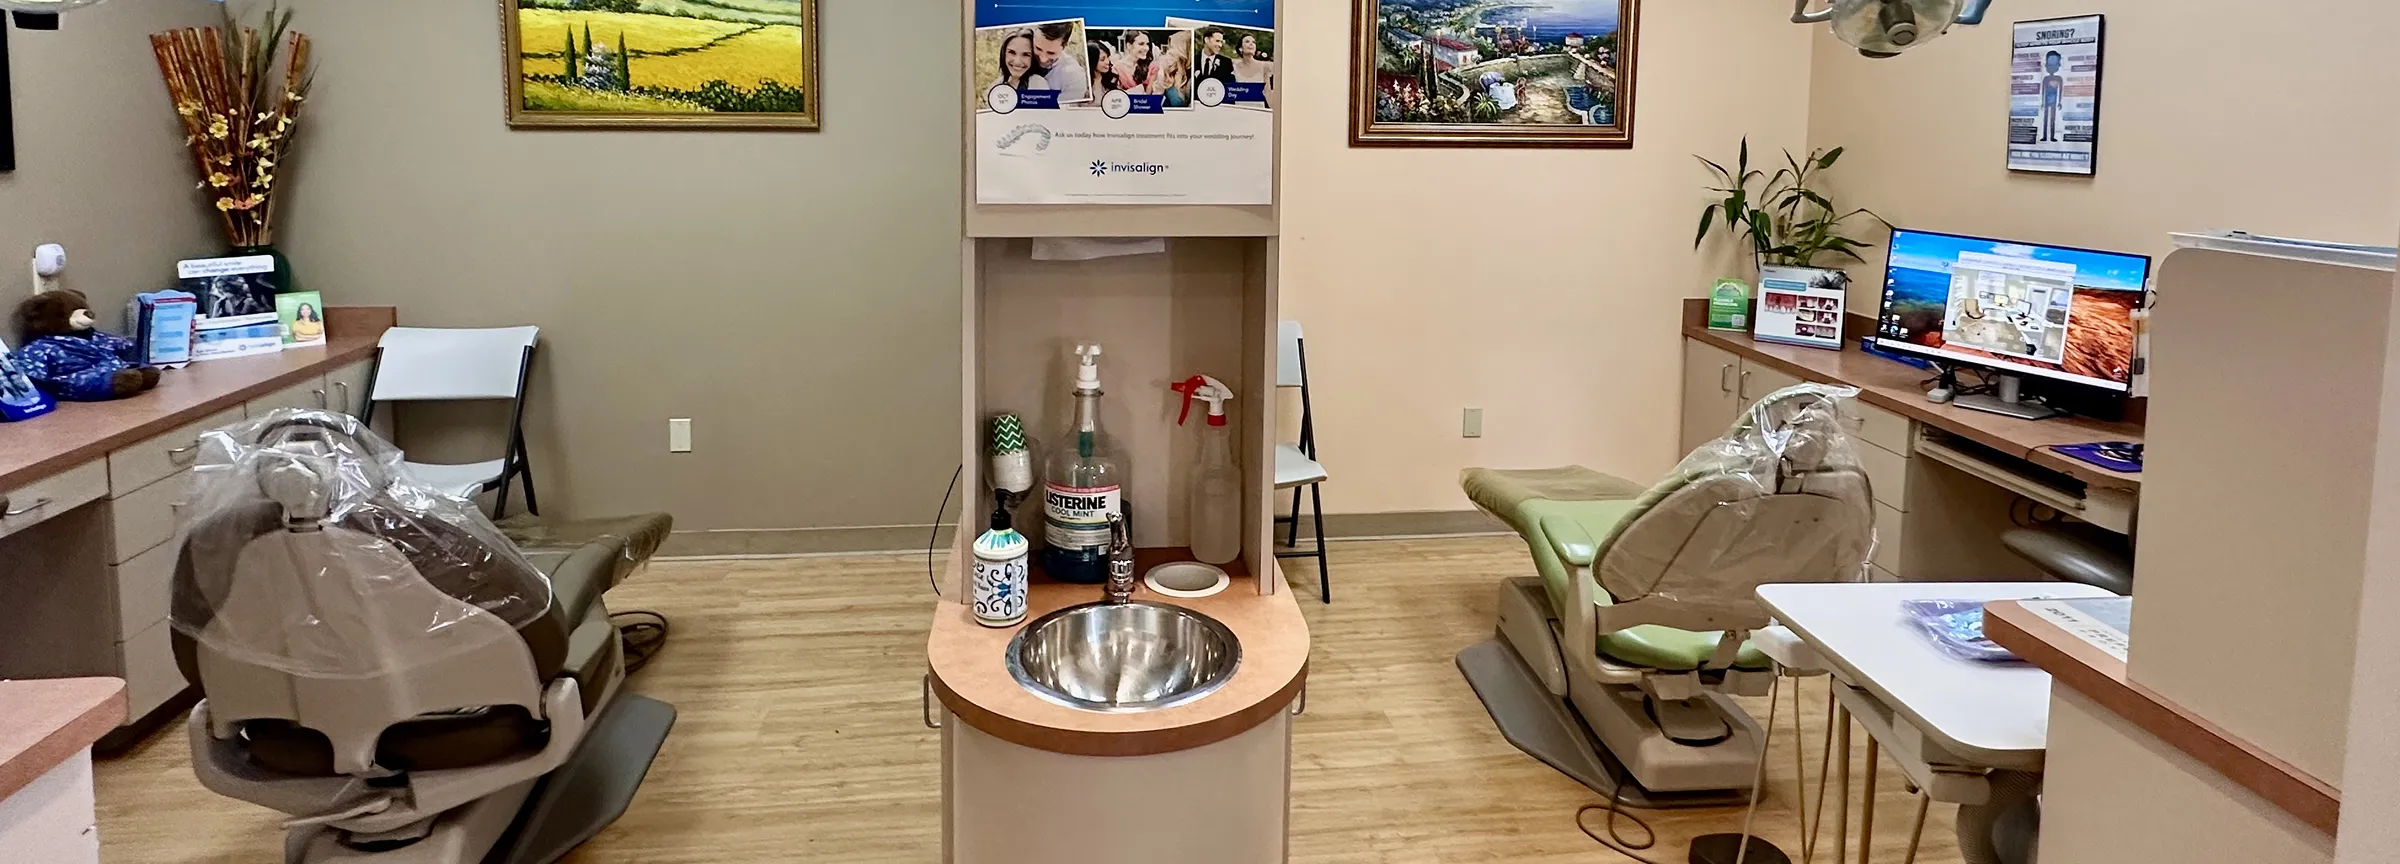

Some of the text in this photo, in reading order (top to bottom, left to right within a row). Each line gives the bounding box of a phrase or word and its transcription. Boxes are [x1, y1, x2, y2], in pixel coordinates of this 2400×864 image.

[2035, 28, 2076, 41] SNORING?
[1046, 490, 1106, 510] LISTERINE
[1051, 507, 1070, 517] COOL
[2044, 607, 2078, 623] 2011
